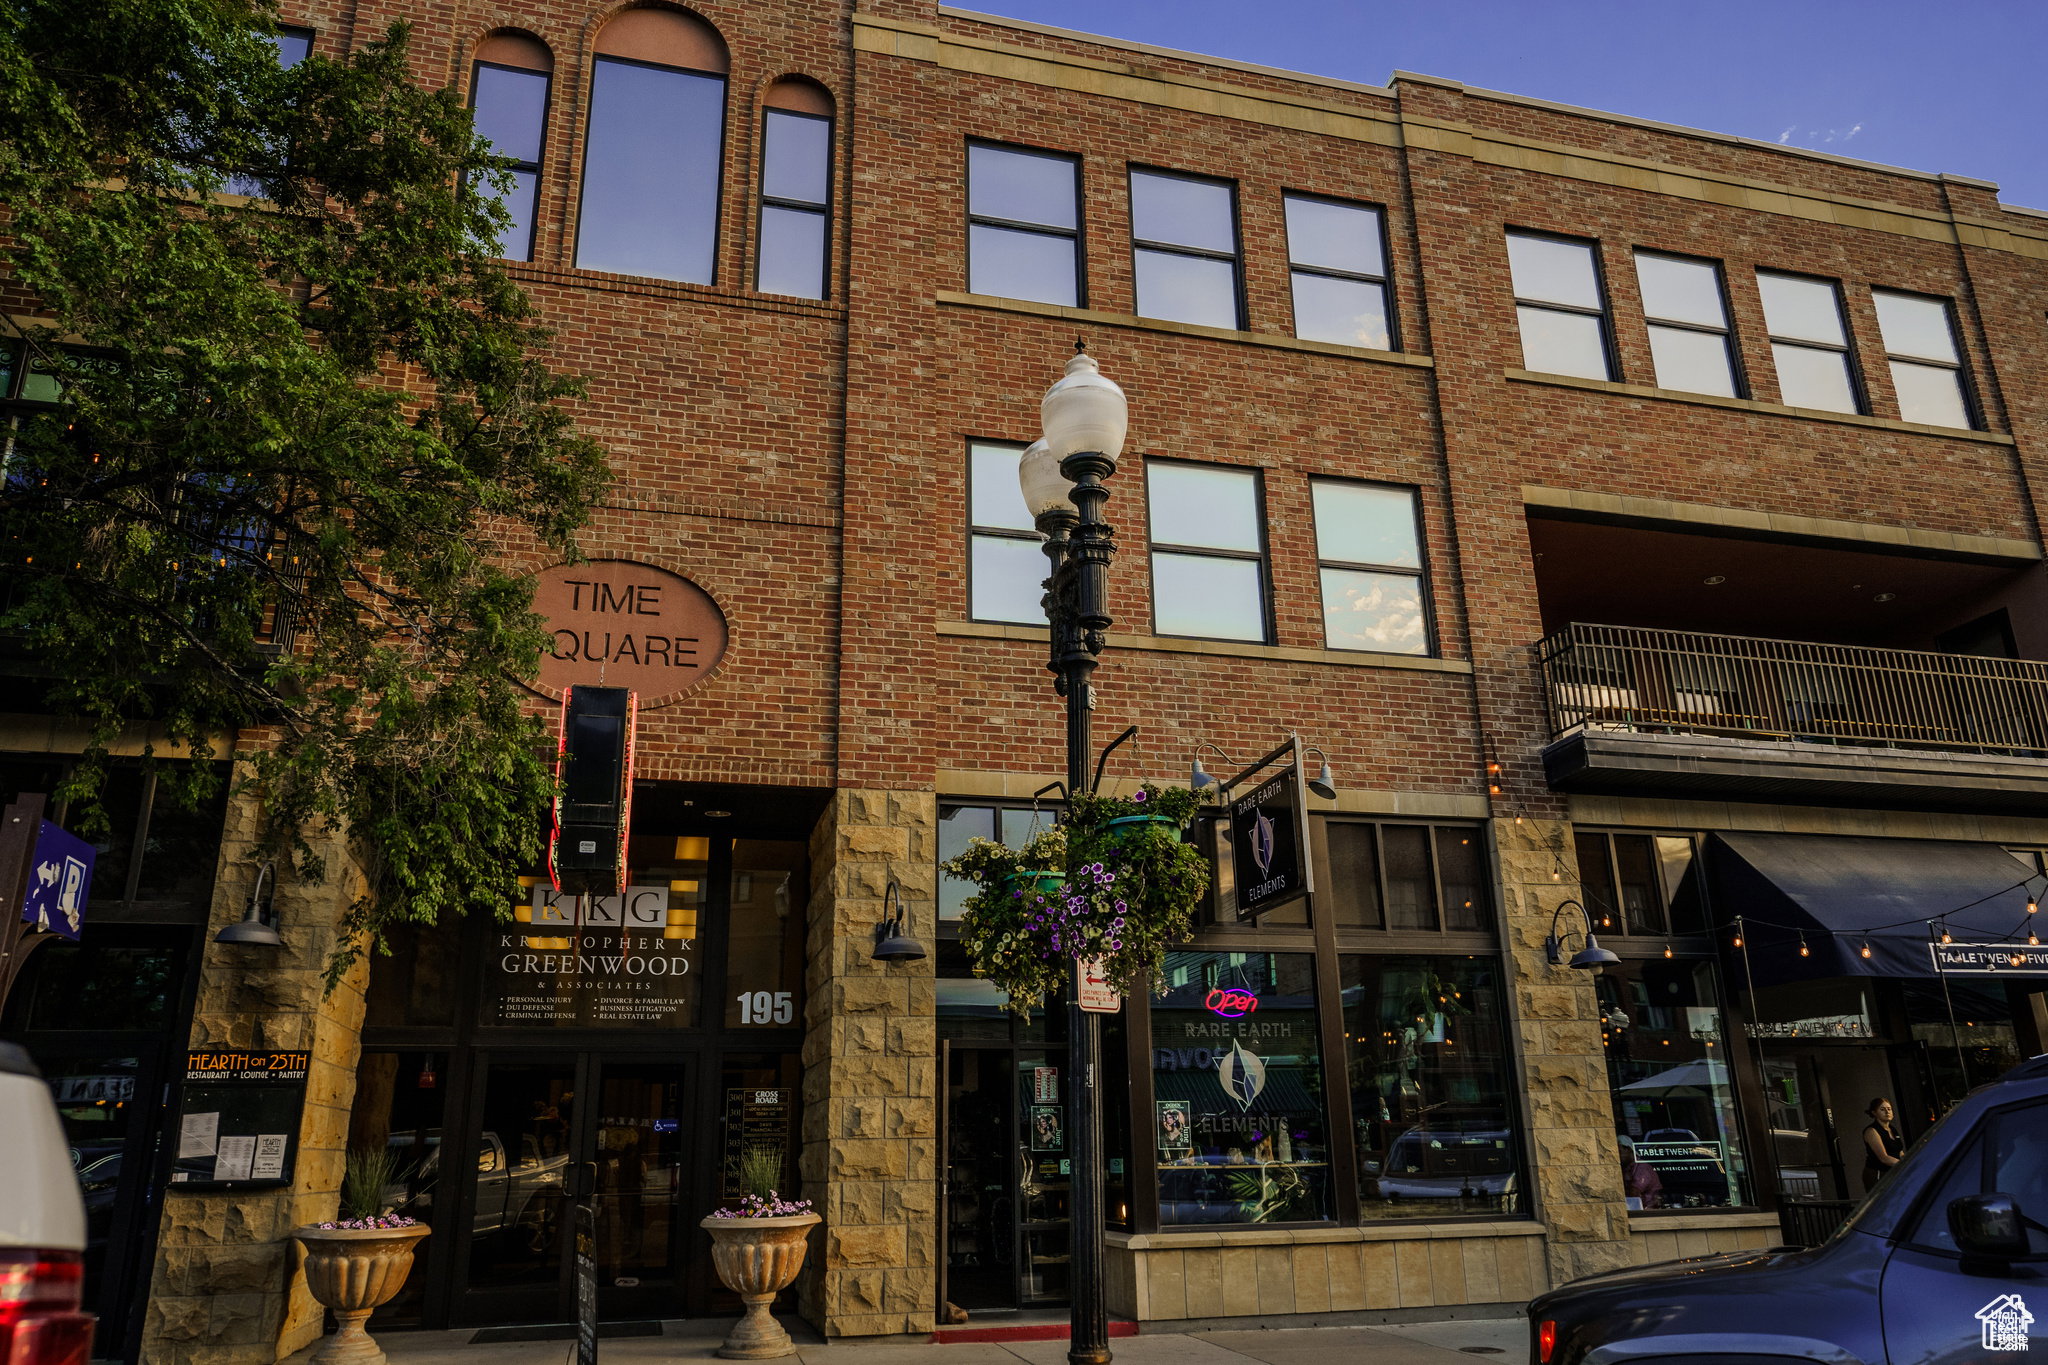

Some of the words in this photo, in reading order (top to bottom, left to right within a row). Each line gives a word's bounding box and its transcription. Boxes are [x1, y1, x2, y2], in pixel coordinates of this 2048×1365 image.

[563, 580, 662, 617] TIME
[540, 628, 699, 668] QUARE
[1238, 795, 1257, 816] RARE
[1258, 780, 1282, 804] EARTH
[1248, 874, 1286, 902] ELEMENTS
[681, 938, 692, 951] K
[501, 953, 690, 977] GREENWOOD
[1939, 952, 1976, 964] TALE
[1977, 952, 2027, 964] TWEN
[538, 981, 546, 989] &
[557, 981, 652, 990] ASSOCIATES
[546, 996, 572, 1004] INJURY
[737, 991, 793, 1024] 195
[1205, 989, 1259, 1013] Open
[1185, 1022, 1231, 1037] RARE
[1237, 1022, 1292, 1037] EARTH
[188, 1054, 249, 1070] HEARTH
[268, 1054, 307, 1070] 25TH
[186, 1070, 230, 1079] RESTAURANT
[240, 1070, 269, 1079] LOUNGE
[278, 1070, 305, 1079] PANTRY
[755, 1090, 779, 1098] CROSS
[1202, 1116, 1289, 1133] ELEMENTS
[1638, 1148, 1665, 1157] TABLE
